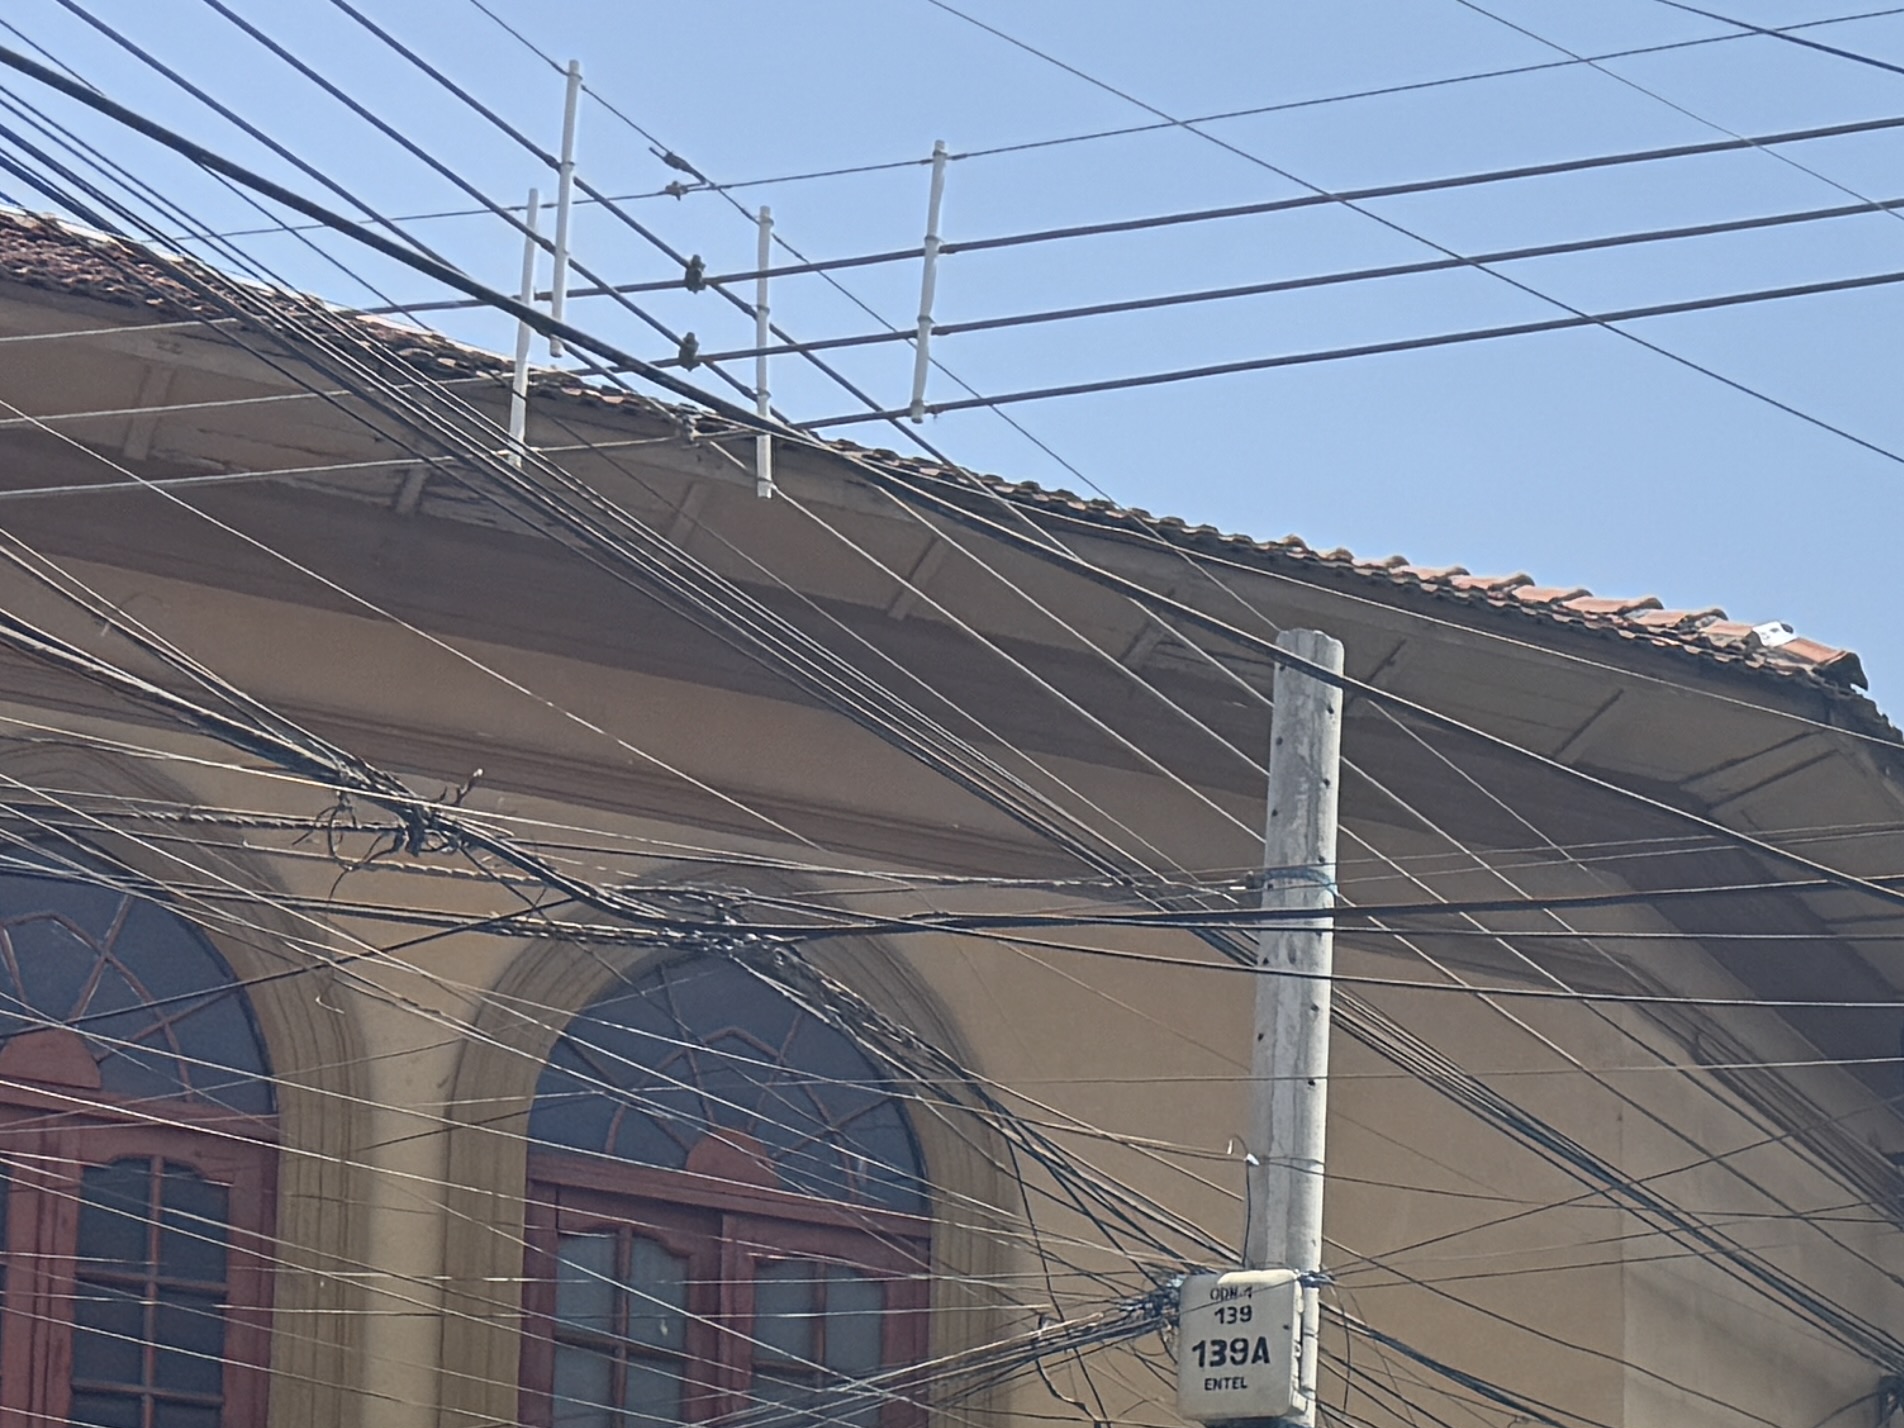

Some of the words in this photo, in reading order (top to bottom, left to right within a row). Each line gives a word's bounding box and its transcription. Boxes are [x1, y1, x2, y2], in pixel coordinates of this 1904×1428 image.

[1214, 1304, 1252, 1325] 139
[1191, 1336, 1271, 1368] 139A
[1204, 1376, 1248, 1391] ENTEL
